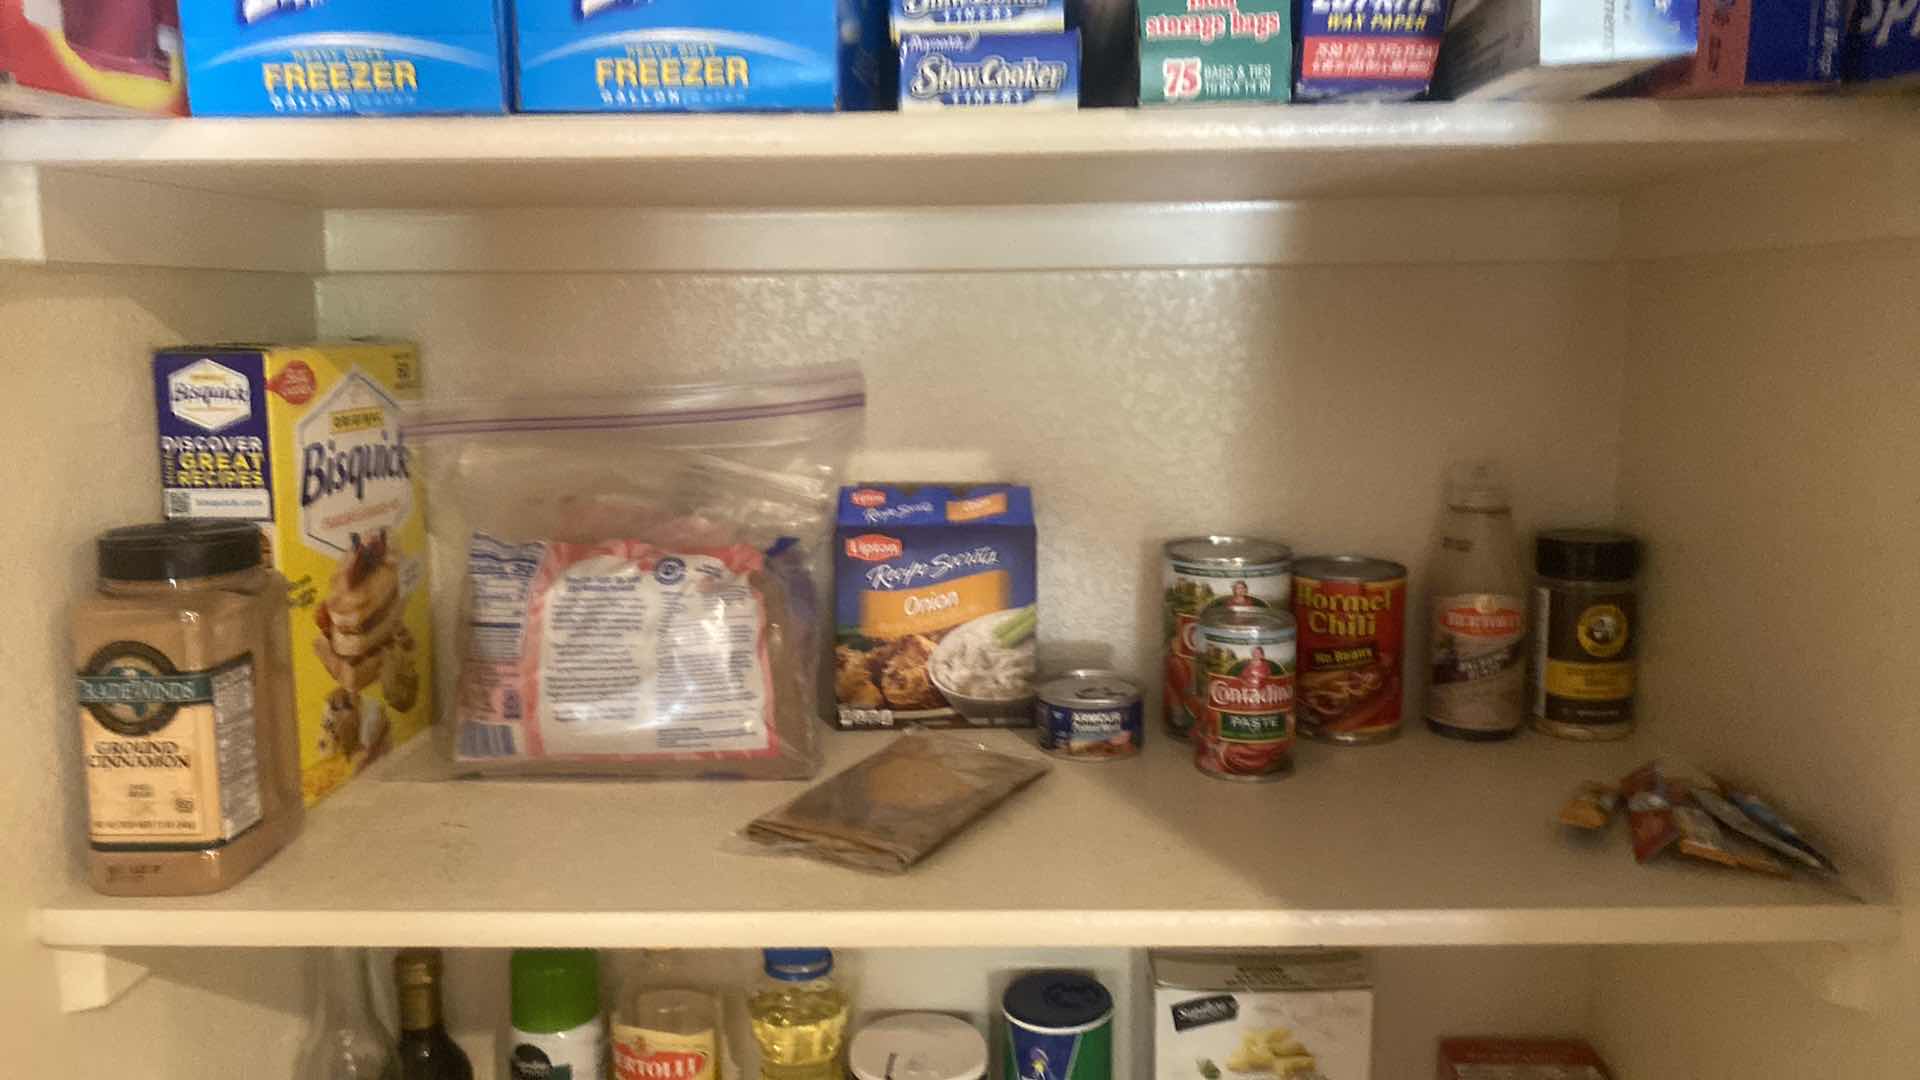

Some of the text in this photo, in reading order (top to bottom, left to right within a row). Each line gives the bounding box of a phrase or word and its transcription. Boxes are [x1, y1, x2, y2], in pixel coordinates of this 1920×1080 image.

[943, 7, 1015, 23] LINERS
[1328, 14, 1428, 32] WAX PAPER
[1145, 9, 1280, 45] storage bags
[262, 61, 419, 92] FREEZER
[595, 56, 749, 88] FREEZER
[911, 55, 1067, 98] Slow Cooker
[1163, 57, 1202, 98] 75
[953, 91, 1026, 106] LINERS
[172, 382, 250, 405] Bisquick
[161, 436, 263, 453] DISCOVER
[179, 452, 264, 470] GREAT
[302, 431, 411, 508] Bisquick
[177, 470, 264, 488] RECIPES
[850, 541, 899, 557] Lipton
[903, 590, 960, 617] Onion
[1296, 585, 1393, 611] Hormel
[1311, 610, 1377, 637] Chili
[1231, 716, 1281, 728] PASTE
[94, 740, 179, 756] GROUND
[89, 754, 191, 770] CINNAMON
